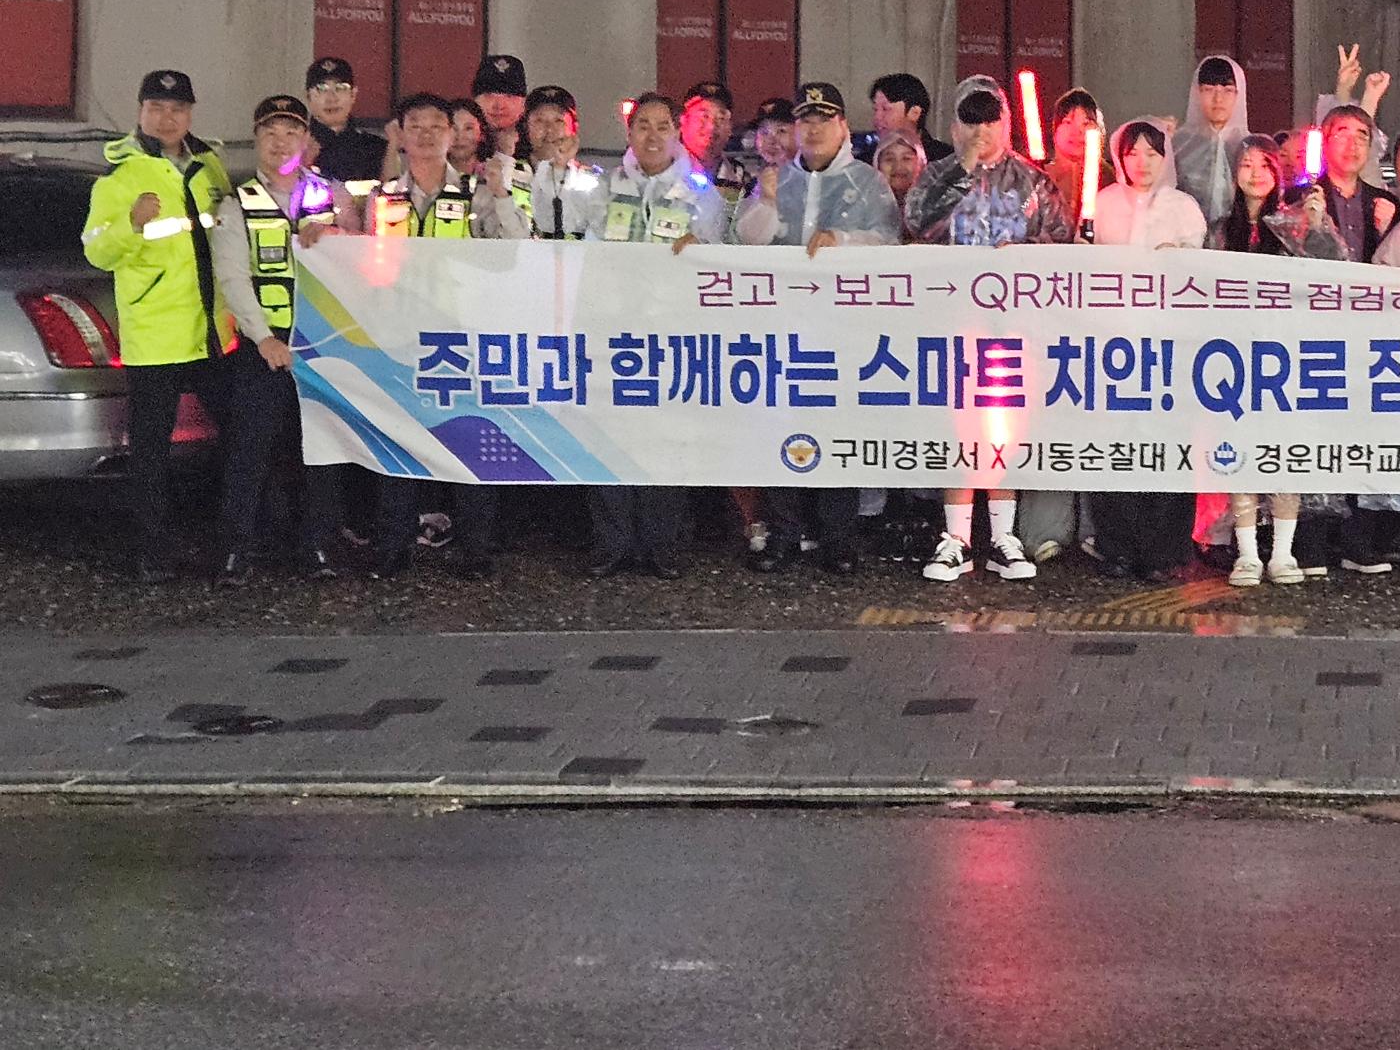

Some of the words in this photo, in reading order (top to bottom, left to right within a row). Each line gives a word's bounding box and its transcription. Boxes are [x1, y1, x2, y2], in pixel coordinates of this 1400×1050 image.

[697, 271, 778, 309] 걷고
[835, 274, 916, 309] 보고
[970, 271, 1294, 314] QR체크리스트로
[417, 331, 593, 408] 주민과
[609, 333, 840, 408] 함께하는
[858, 335, 1027, 410] 스마트
[1044, 336, 1175, 413] 치안!
[1192, 338, 1350, 421] QR로
[831, 439, 980, 473] 구미경찰서
[1018, 442, 1167, 474] 기동순찰대
[1177, 444, 1195, 473] X
